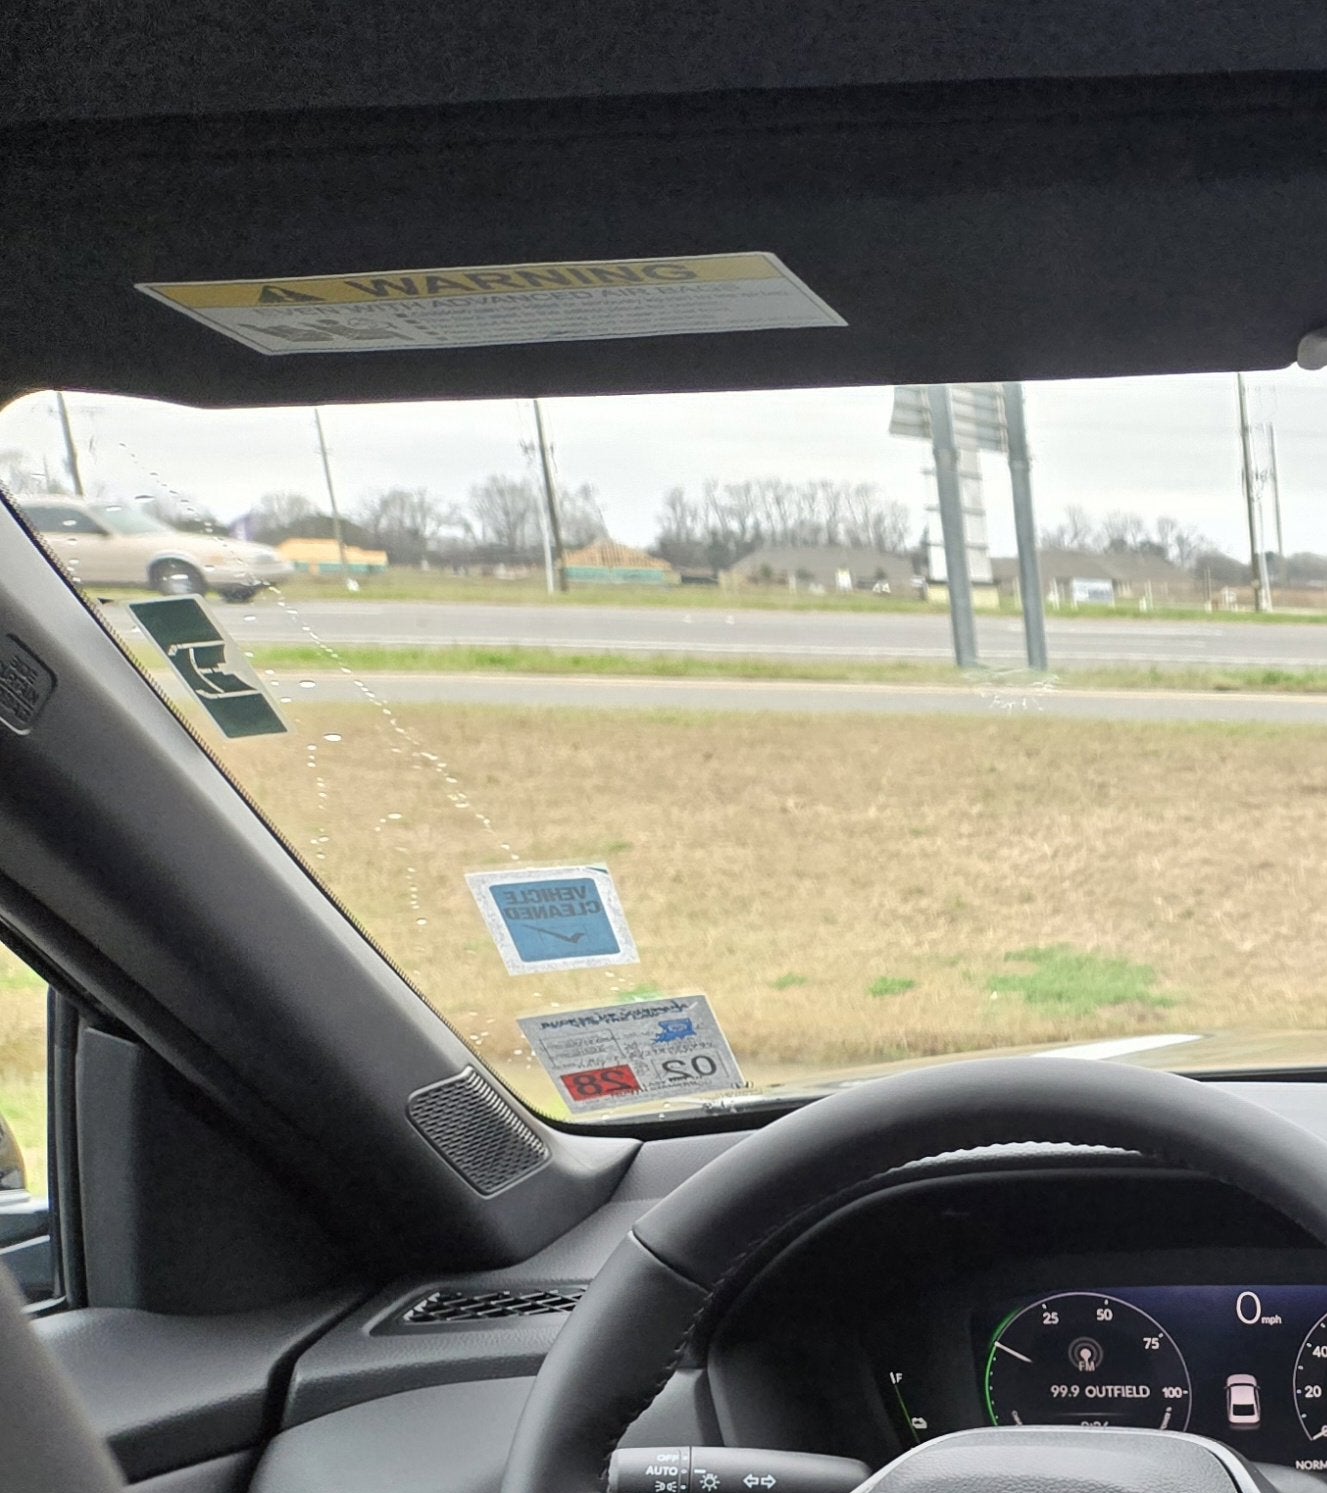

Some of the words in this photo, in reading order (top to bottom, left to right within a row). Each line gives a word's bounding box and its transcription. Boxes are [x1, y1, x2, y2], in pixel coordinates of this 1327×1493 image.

[343, 263, 697, 297] WARNING
[1236, 1290, 1262, 1325] 0
[1261, 1314, 1282, 1326] mph
[1042, 1312, 1059, 1324] 25
[1096, 1309, 1113, 1321] 50
[1143, 1337, 1161, 1350] 75
[1050, 1385, 1080, 1398] 99.9
[1085, 1385, 1151, 1398] OUTFIELD
[1162, 1387, 1182, 1399] 100
[1304, 1386, 1322, 1398] 20
[657, 1453, 679, 1463] OFF
[646, 1465, 678, 1476] AUTO
